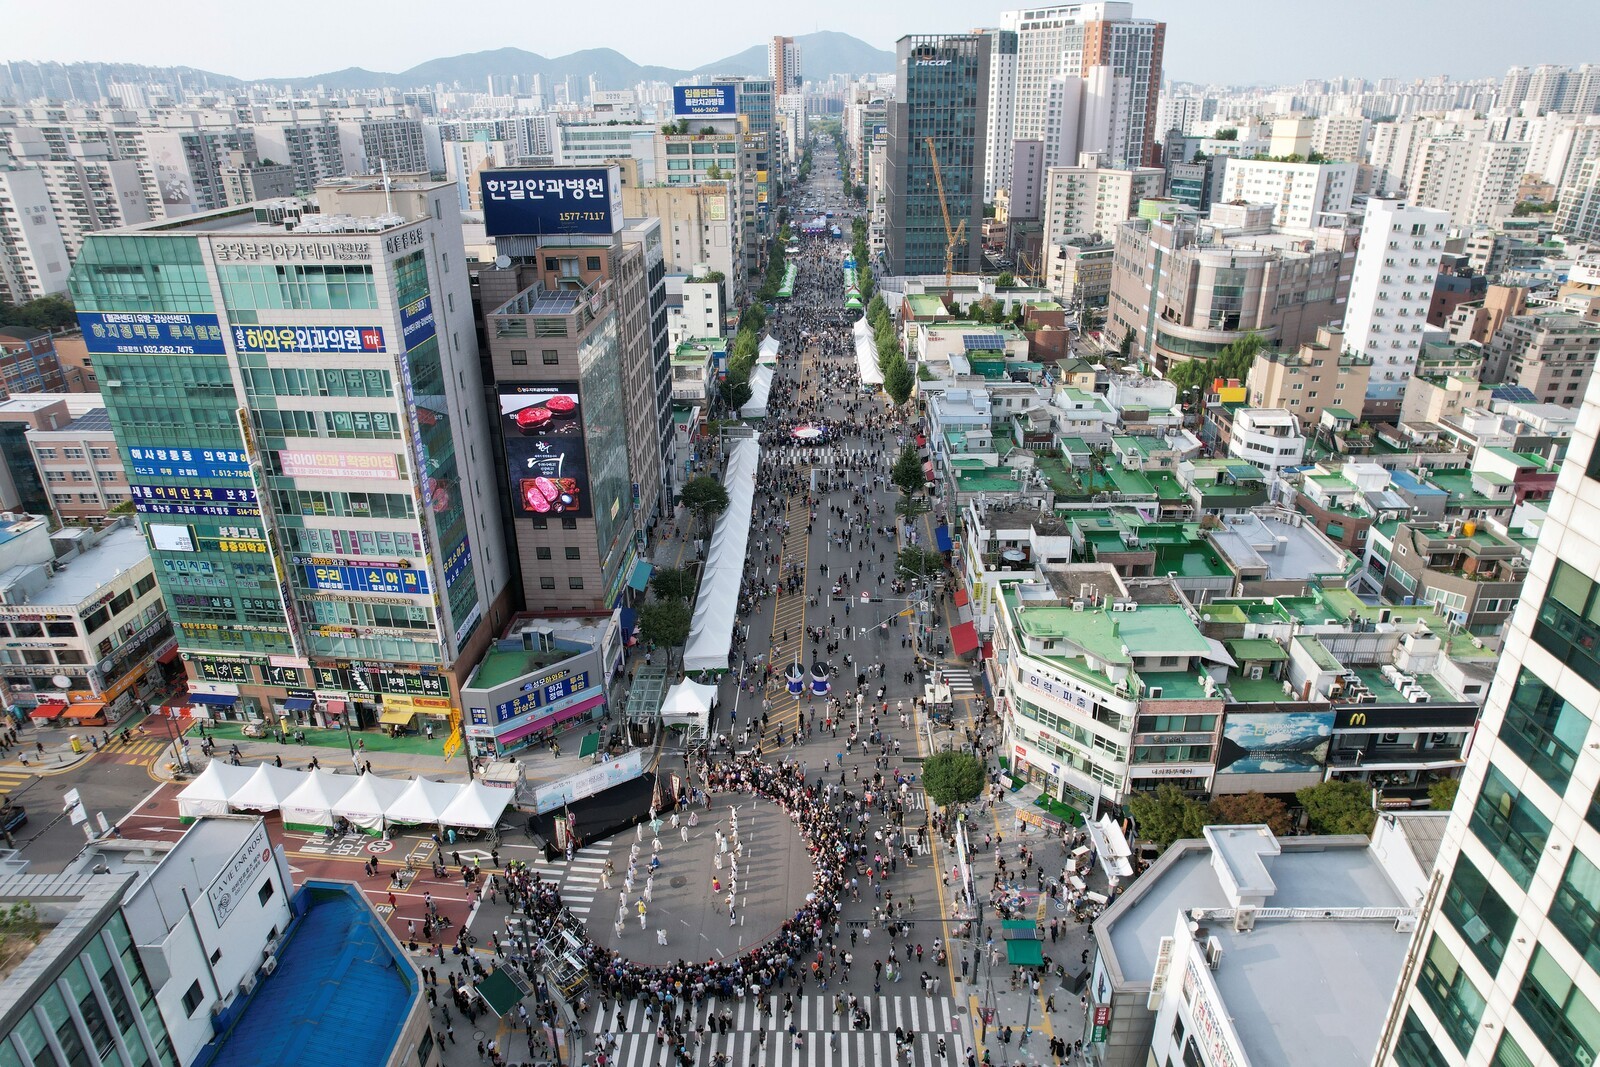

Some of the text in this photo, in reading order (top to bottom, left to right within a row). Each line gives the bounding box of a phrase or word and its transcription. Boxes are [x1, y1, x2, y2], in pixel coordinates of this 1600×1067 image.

[486, 178, 604, 200] 한길안과병원
[560, 212, 605, 220] 1577-7117
[214, 242, 337, 261] 올댓뷰티아카데미
[246, 329, 362, 350] 하와유외과의원
[364, 334, 380, 345] 11F
[143, 346, 194, 354] 032.262.7475
[326, 370, 383, 388] 에듀윌
[335, 413, 391, 432] 에듀윌
[362, 533, 410, 548] 피부과
[316, 569, 417, 586] 우리 소아과
[388, 678, 404, 687] 부평
[406, 678, 421, 688] 그린
[212, 886, 224, 900] LA
